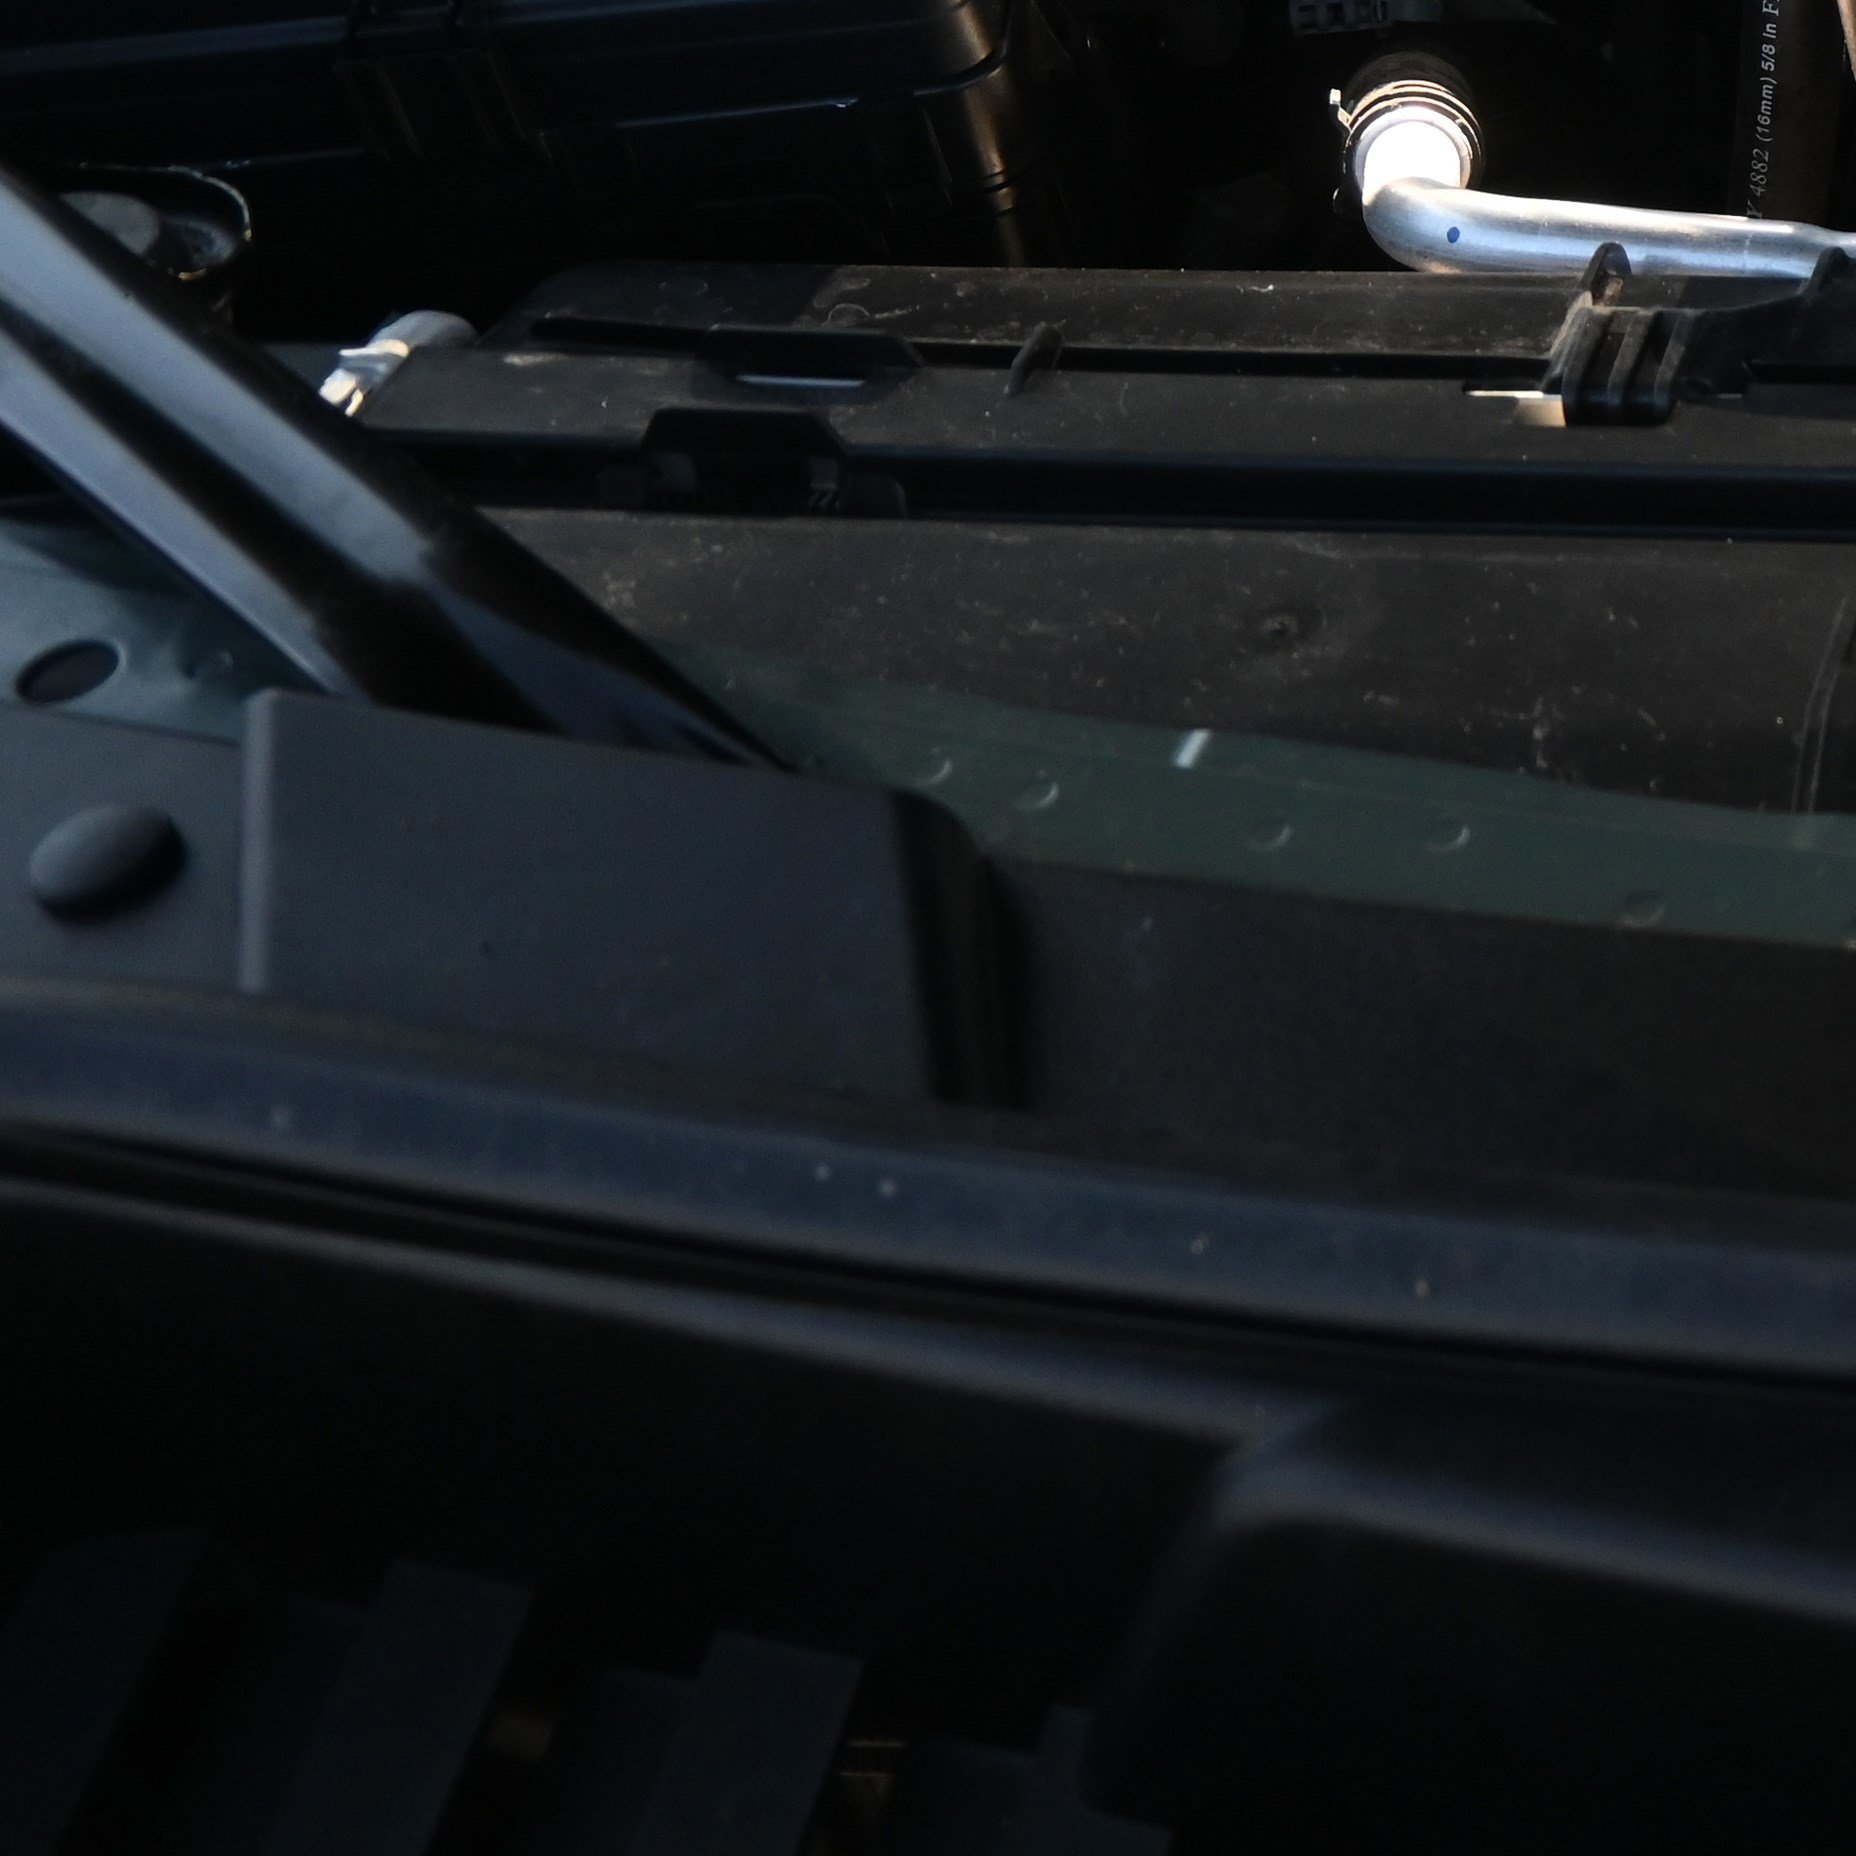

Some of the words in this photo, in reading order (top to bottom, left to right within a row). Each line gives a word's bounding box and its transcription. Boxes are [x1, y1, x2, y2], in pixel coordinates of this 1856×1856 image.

[1761, 43, 1776, 72] 5/8
[1755, 76, 1778, 143] (16mm)
[1750, 148, 1770, 197] 4882
